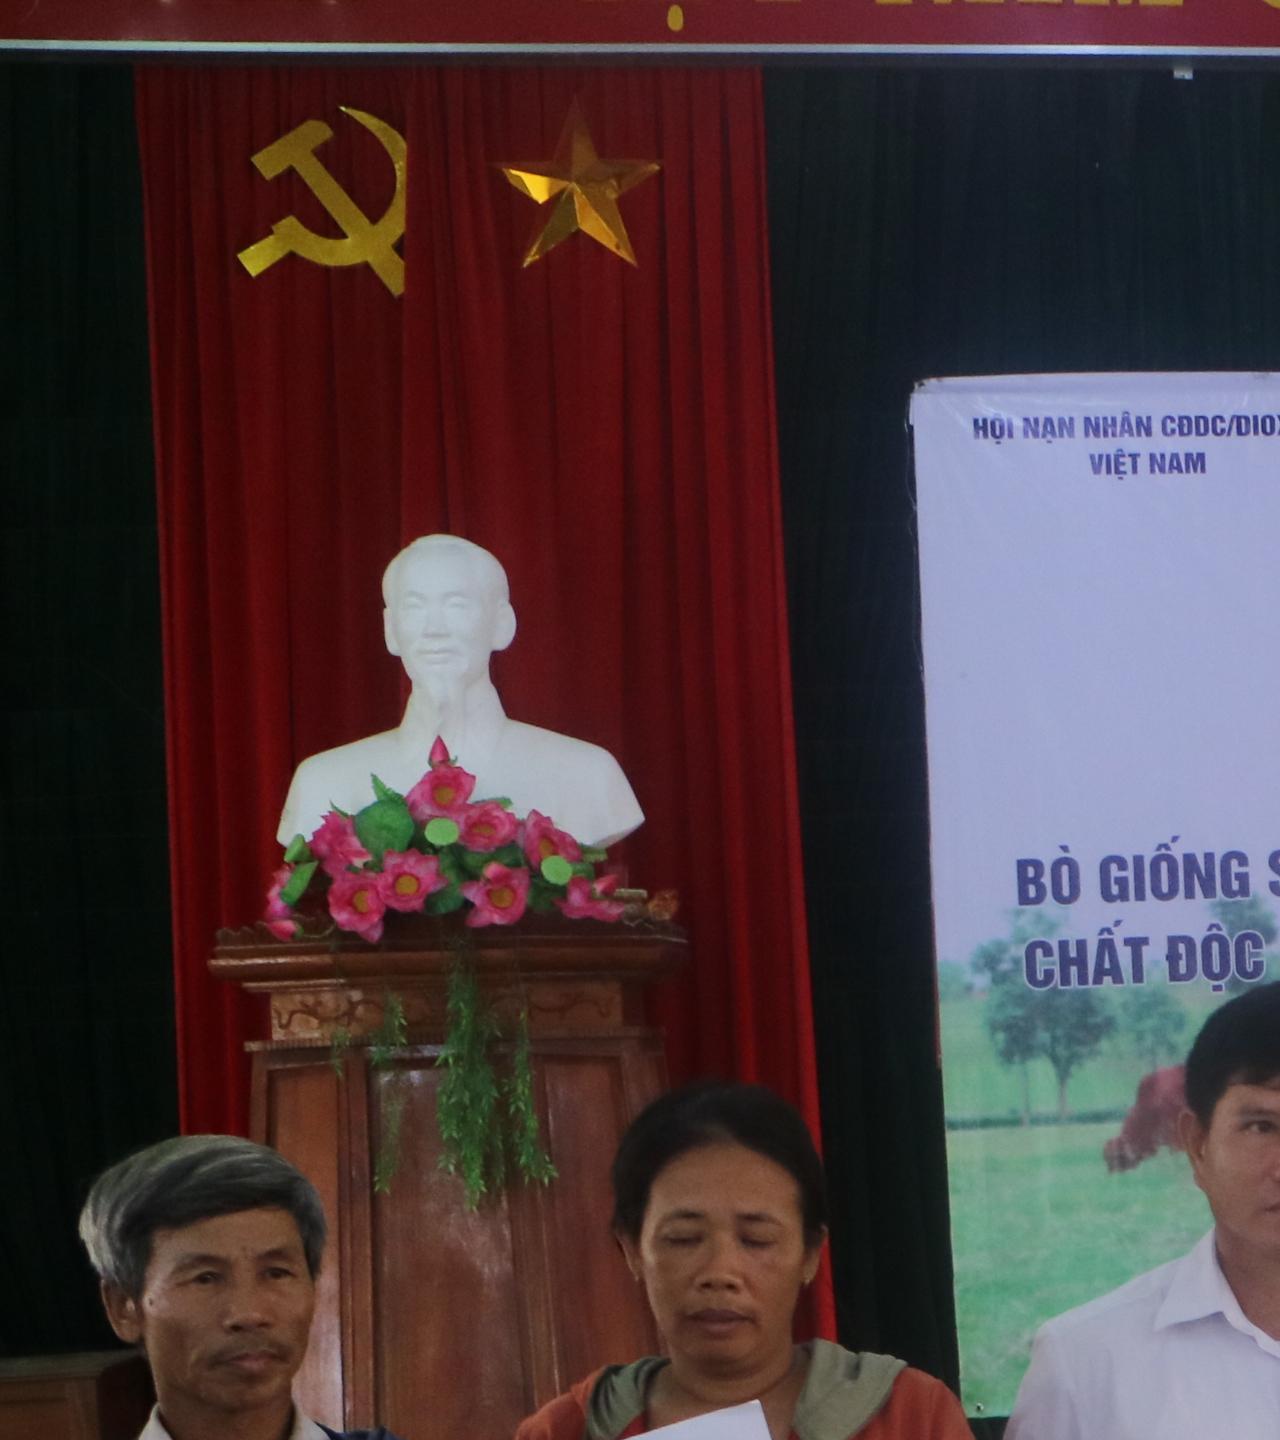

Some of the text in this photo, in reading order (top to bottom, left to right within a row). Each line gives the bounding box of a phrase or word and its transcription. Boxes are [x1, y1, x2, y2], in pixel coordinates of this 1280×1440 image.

[972, 412, 1013, 439] HỘI
[1022, 416, 1074, 438] NẠN
[1083, 411, 1152, 438] NHÂN
[1089, 448, 1206, 480] VIỆT NAM
[1016, 847, 1081, 905] BÒ
[1100, 836, 1251, 902] GIỐNG
[1024, 920, 1150, 990] CHẤT
[1165, 923, 1265, 992] ĐỘC
